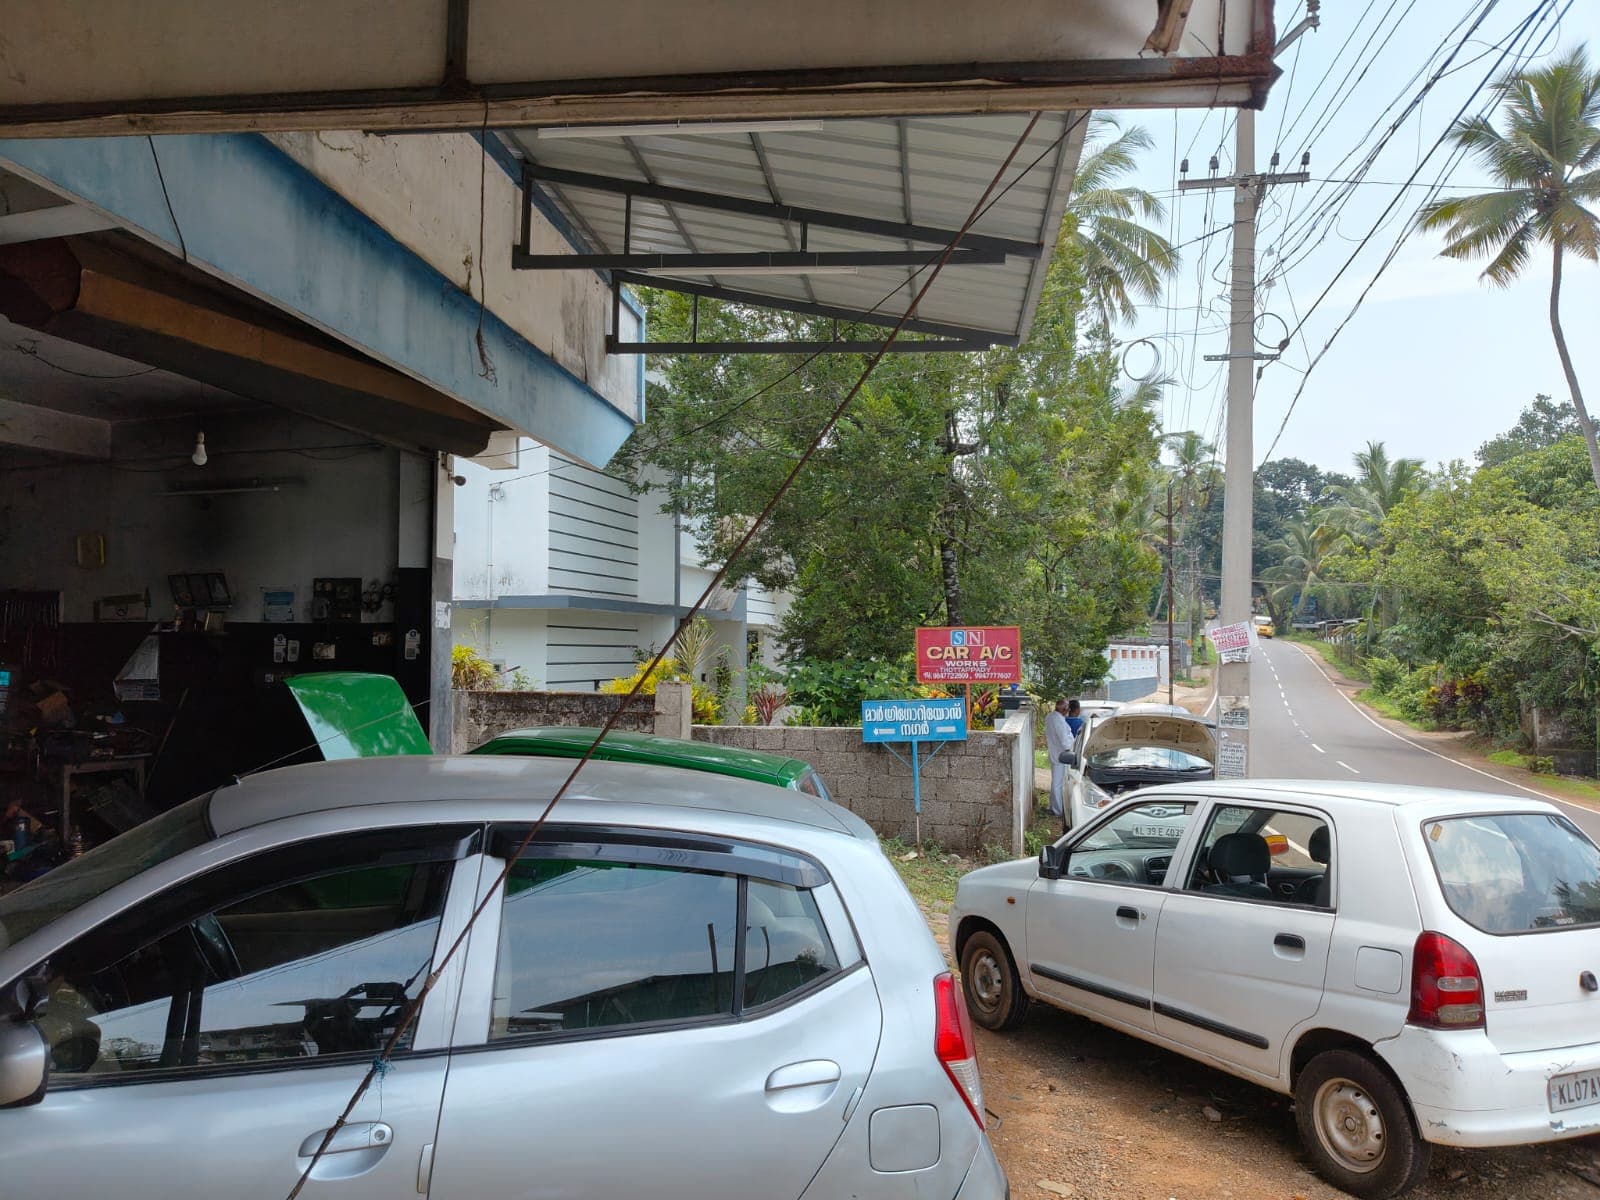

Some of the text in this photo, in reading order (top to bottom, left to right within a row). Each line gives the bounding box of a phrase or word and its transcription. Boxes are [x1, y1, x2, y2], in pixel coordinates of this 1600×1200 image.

[926, 644, 1012, 661] CAR A/C
[1158, 828, 1163, 836] E
